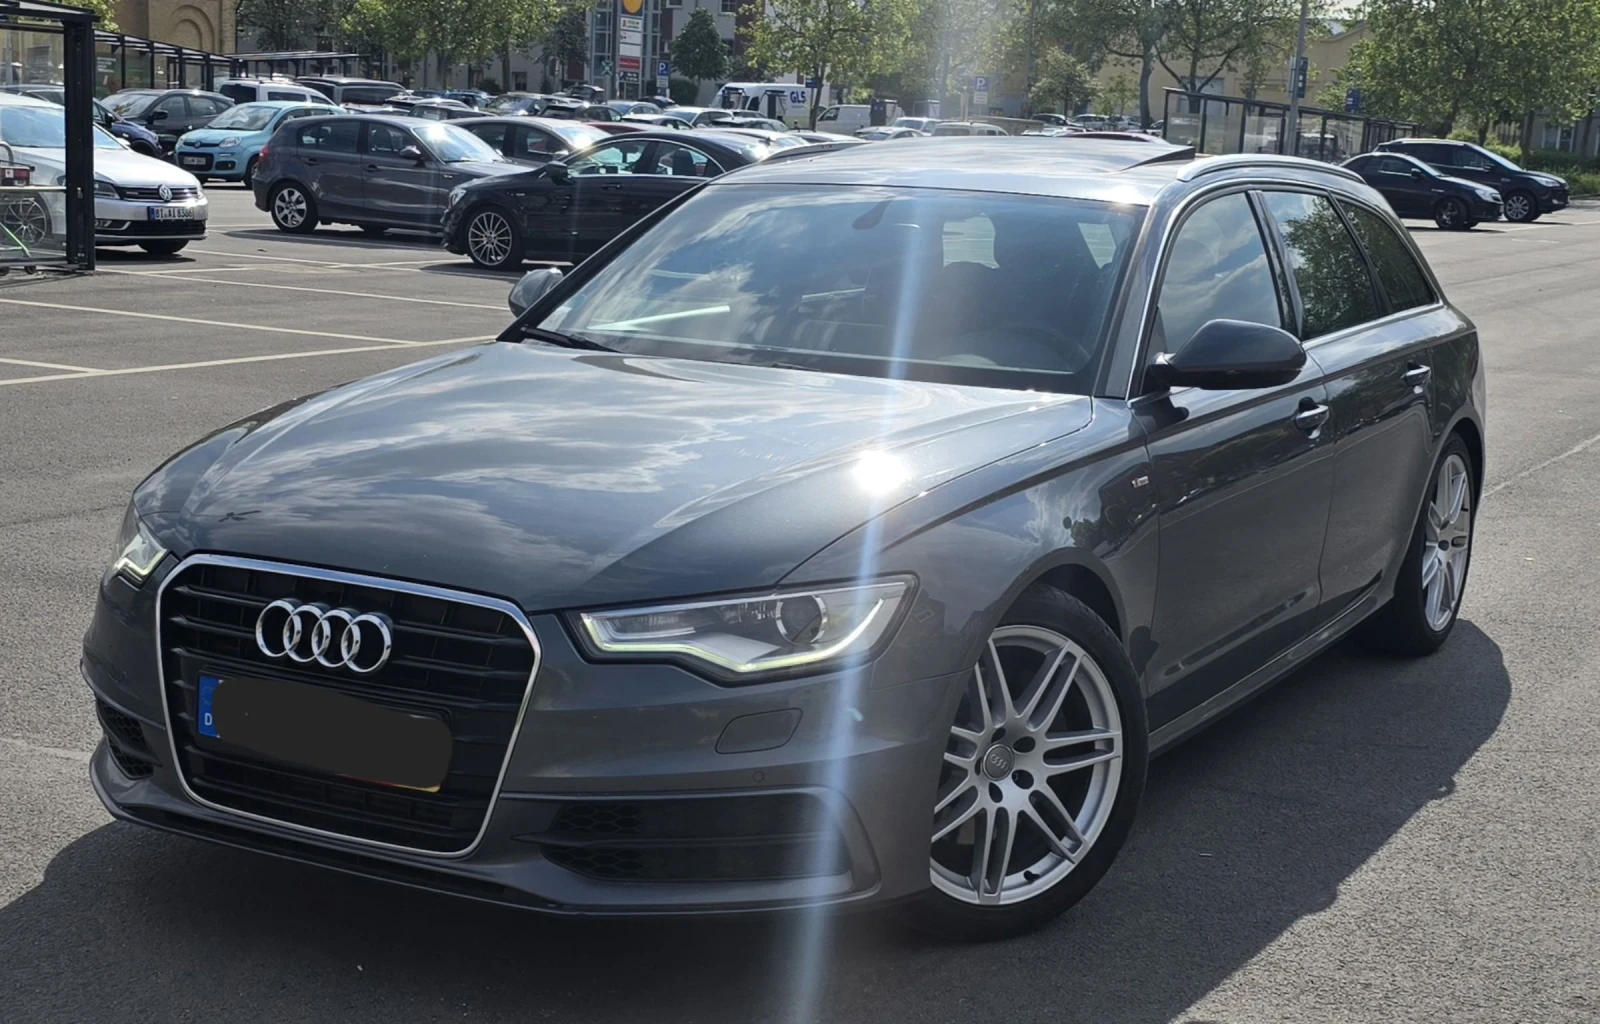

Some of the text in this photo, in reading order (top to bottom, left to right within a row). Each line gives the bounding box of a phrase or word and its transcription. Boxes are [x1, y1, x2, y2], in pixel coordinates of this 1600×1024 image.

[659, 62, 666, 73] P
[977, 78, 986, 89] P
[790, 90, 806, 104] GLS
[204, 712, 213, 726] D
